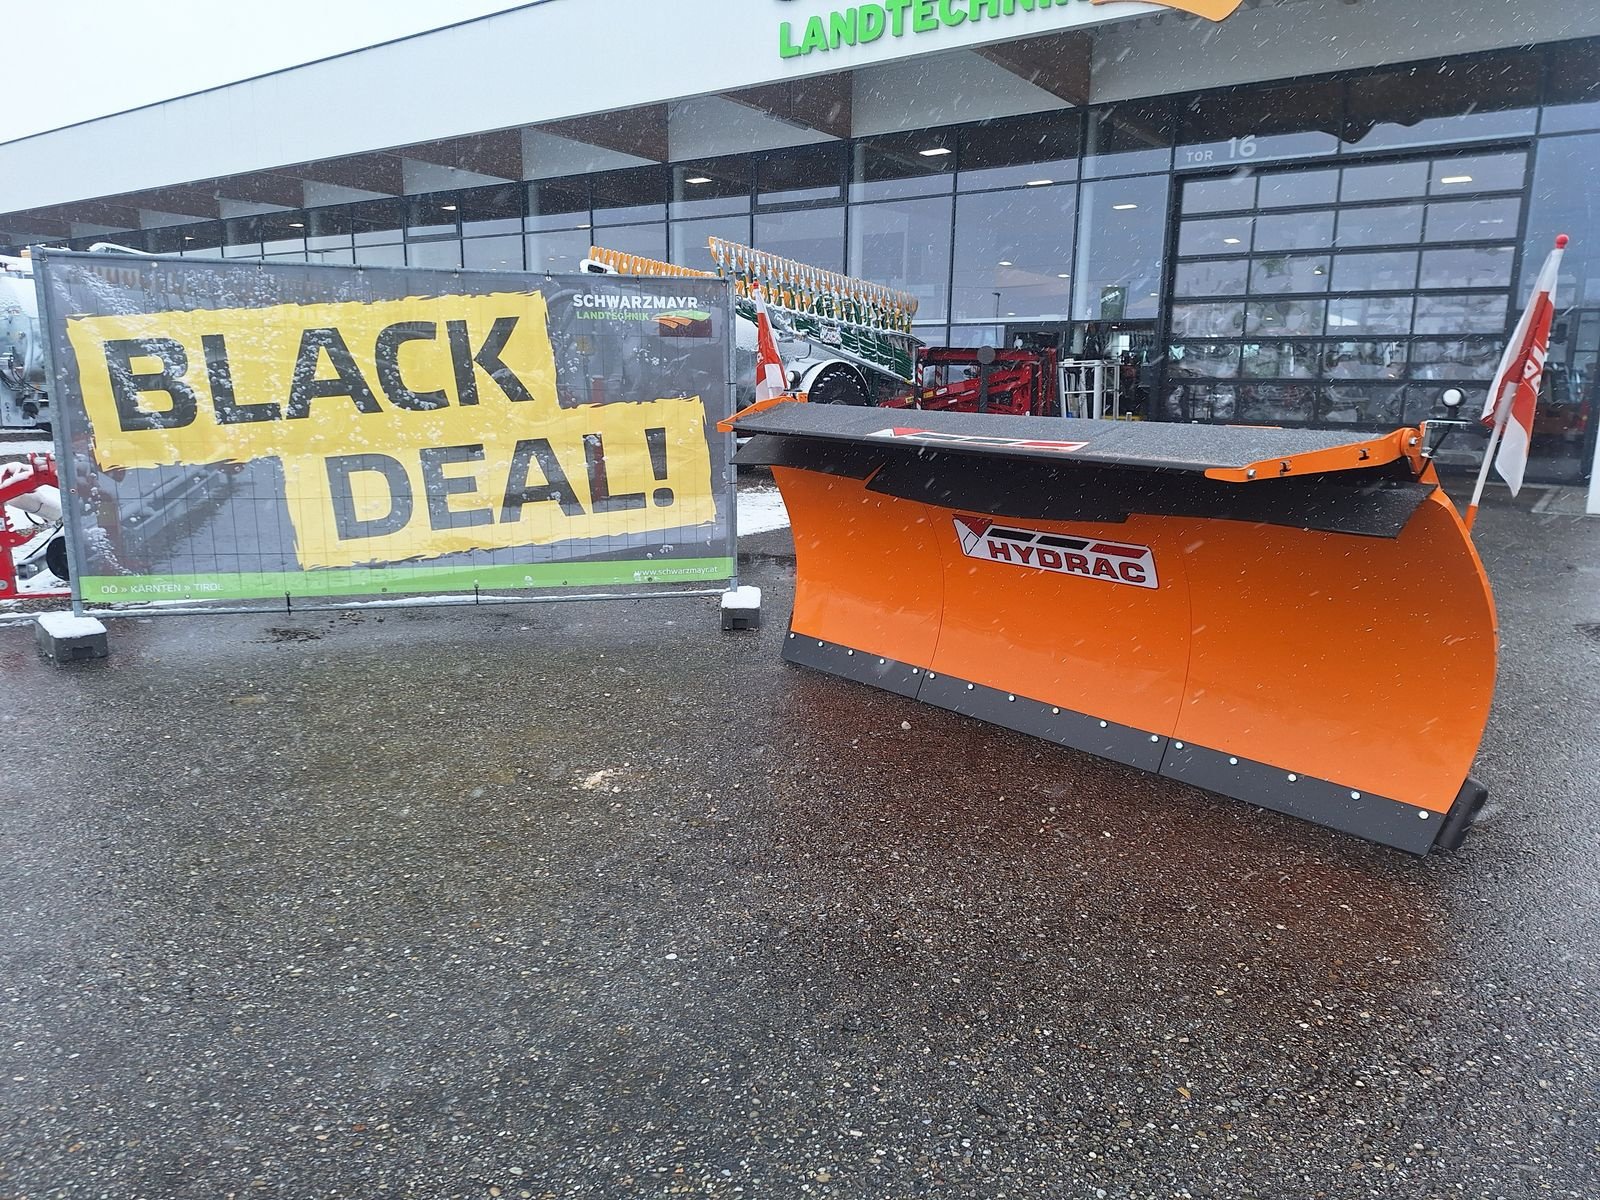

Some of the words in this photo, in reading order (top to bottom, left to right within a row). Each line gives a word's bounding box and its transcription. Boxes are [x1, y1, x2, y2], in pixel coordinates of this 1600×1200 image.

[1186, 150, 1214, 162] TOR
[1228, 134, 1257, 158] 16
[573, 294, 698, 309] SCHWARZMAYR
[576, 311, 649, 321] LANDTECHNIK
[103, 316, 535, 432] BLACK
[325, 427, 675, 541] DEAL!
[633, 566, 718, 577] www.schwarzmayr.at
[987, 540, 1146, 583] HYDRAC
[130, 583, 181, 593] KÄRNTEN
[194, 583, 224, 592] TIROL
